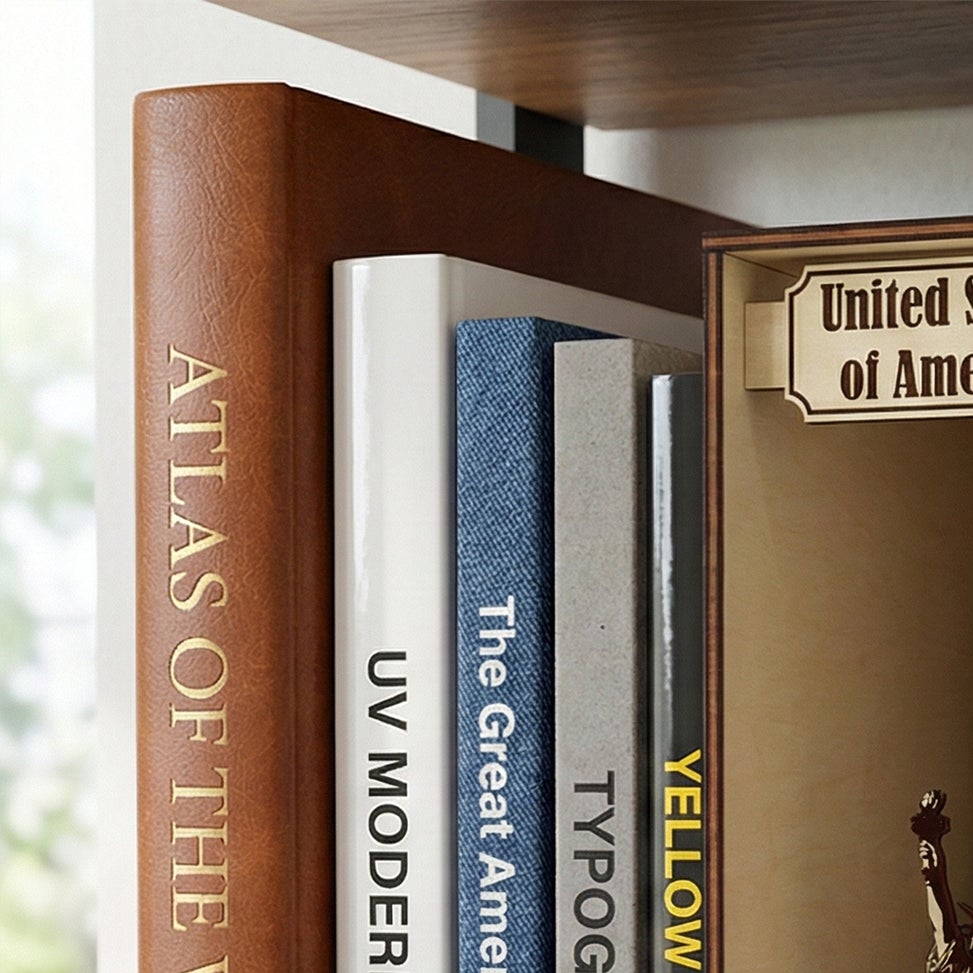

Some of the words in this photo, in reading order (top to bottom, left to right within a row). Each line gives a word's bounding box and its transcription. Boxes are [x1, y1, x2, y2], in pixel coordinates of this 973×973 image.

[820, 276, 950, 332] United
[840, 349, 879, 400] of
[166, 345, 228, 613] ATLAS
[168, 636, 229, 746] OF
[367, 649, 410, 731] UV
[476, 595, 517, 689] The
[477, 702, 517, 840] Great
[169, 767, 229, 932] THE
[662, 749, 703, 971] YELLOW
